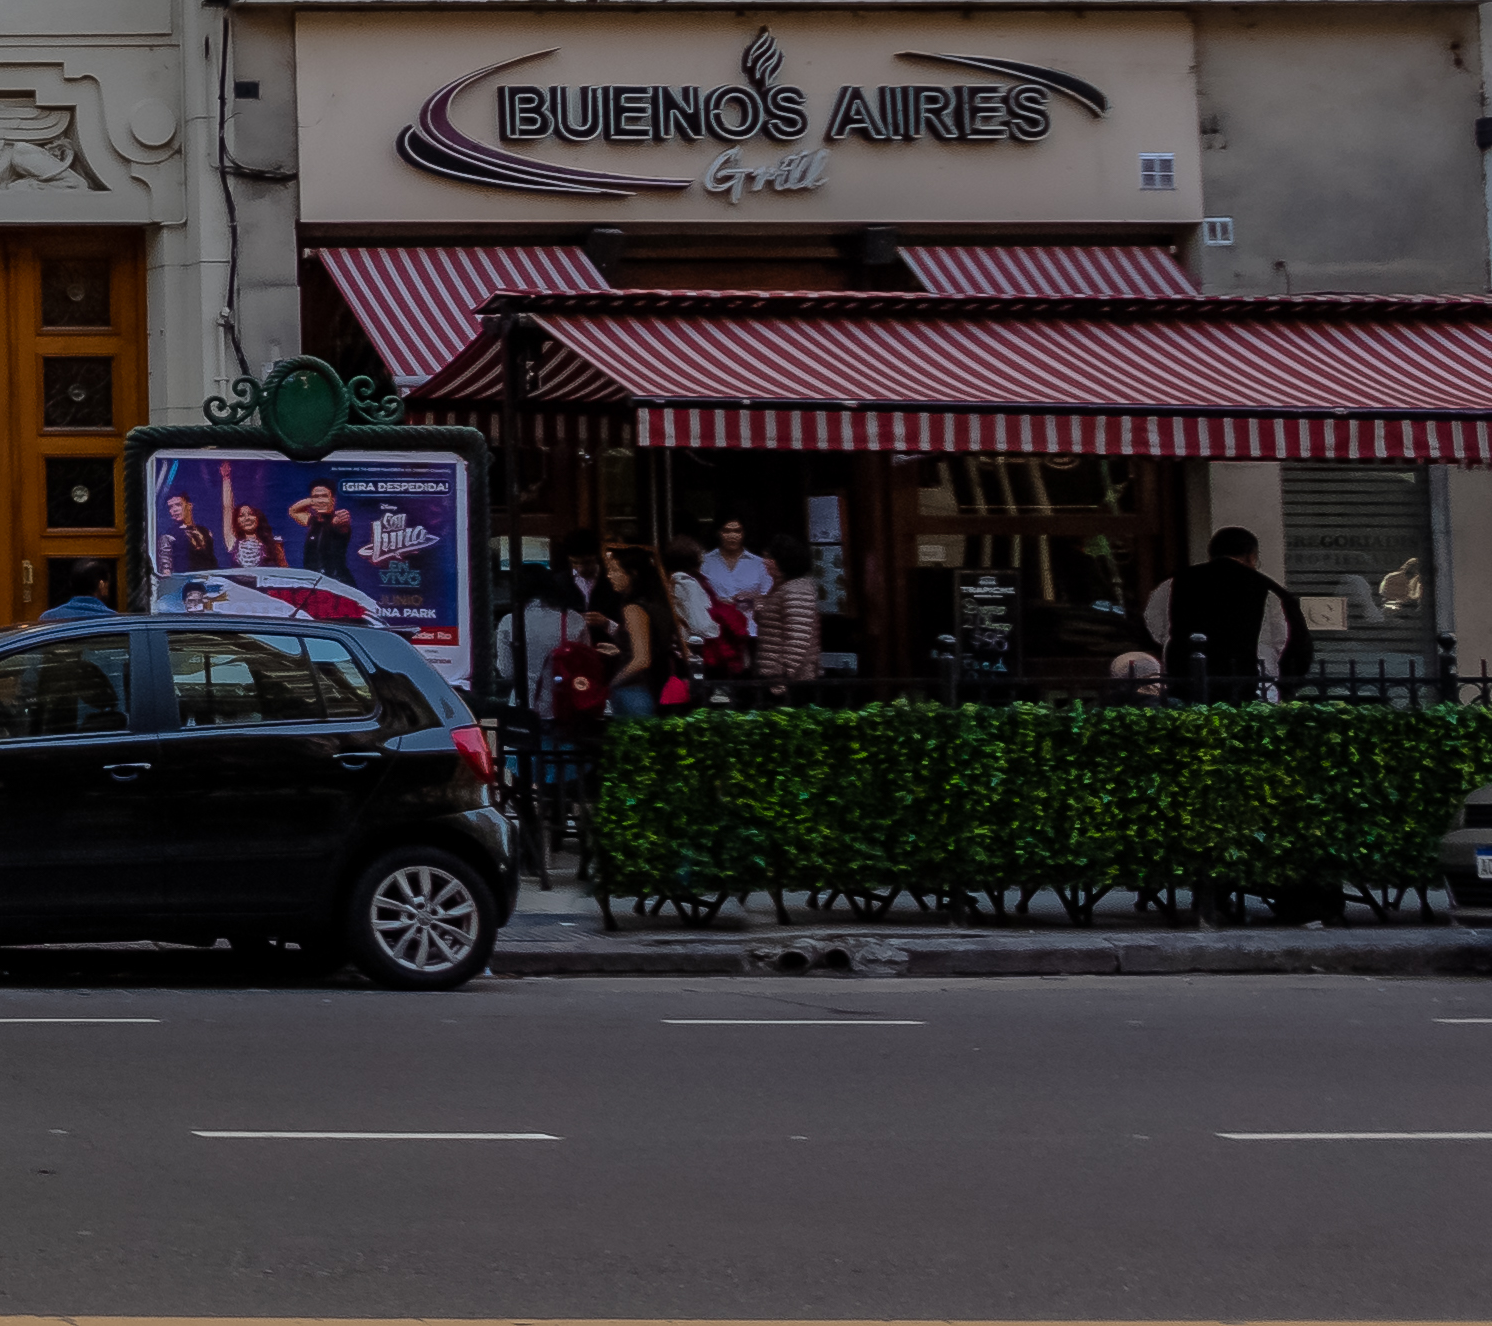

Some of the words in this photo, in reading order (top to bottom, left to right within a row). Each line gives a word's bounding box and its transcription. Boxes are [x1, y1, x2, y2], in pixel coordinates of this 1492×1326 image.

[498, 84, 809, 141] BUENOS
[825, 84, 1052, 141] AIRES
[703, 145, 830, 204] Grill
[377, 482, 449, 492] DESPEDIDA!
[379, 571, 422, 584] VIVO
[379, 595, 423, 606] JUNIO
[403, 608, 436, 618] PARK
